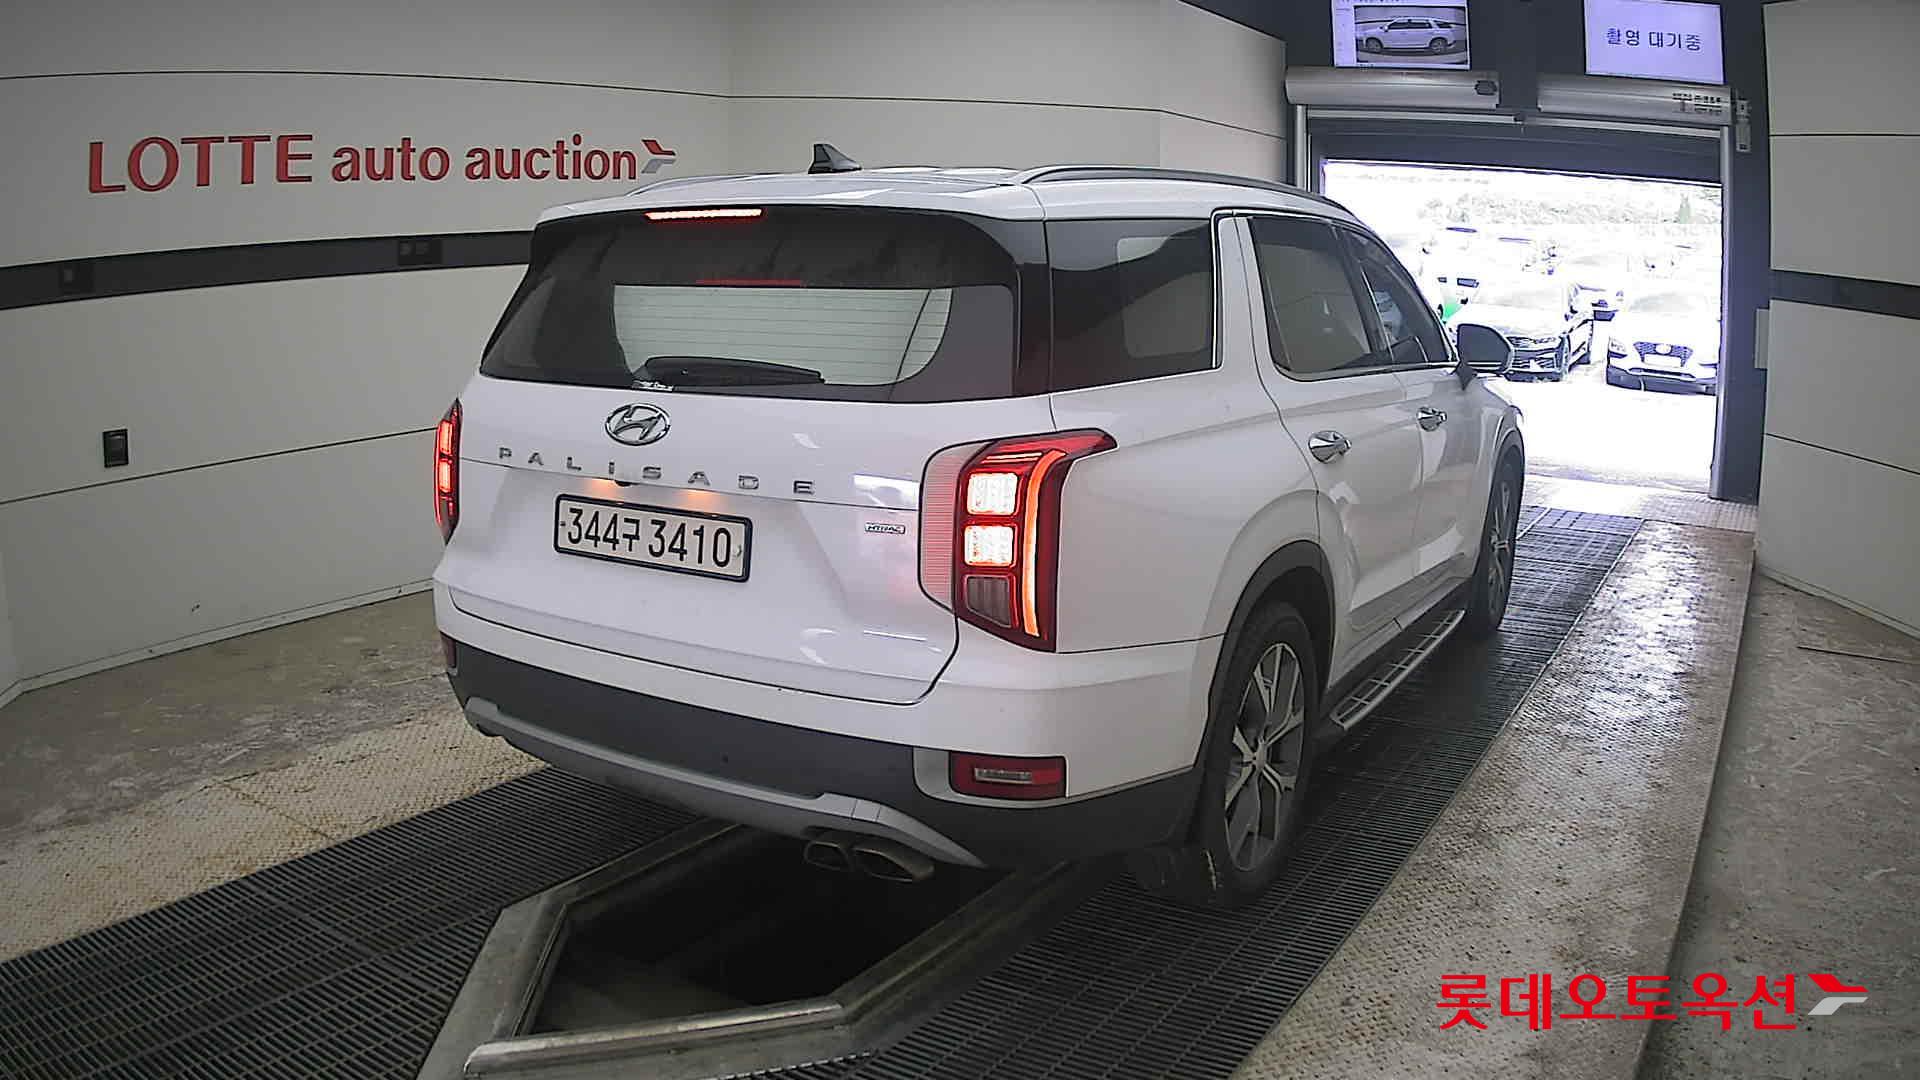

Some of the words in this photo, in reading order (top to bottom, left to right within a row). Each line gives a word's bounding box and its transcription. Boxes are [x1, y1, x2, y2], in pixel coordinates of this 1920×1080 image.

[1607, 27, 1640, 47] 촬영
[1648, 31, 1701, 51] 대기중
[88, 134, 313, 194] LOTTE
[331, 137, 450, 182] auto
[464, 133, 638, 181] auction
[498, 446, 817, 496] PALISADE
[566, 507, 641, 553] 344구
[648, 519, 732, 568] 3410
